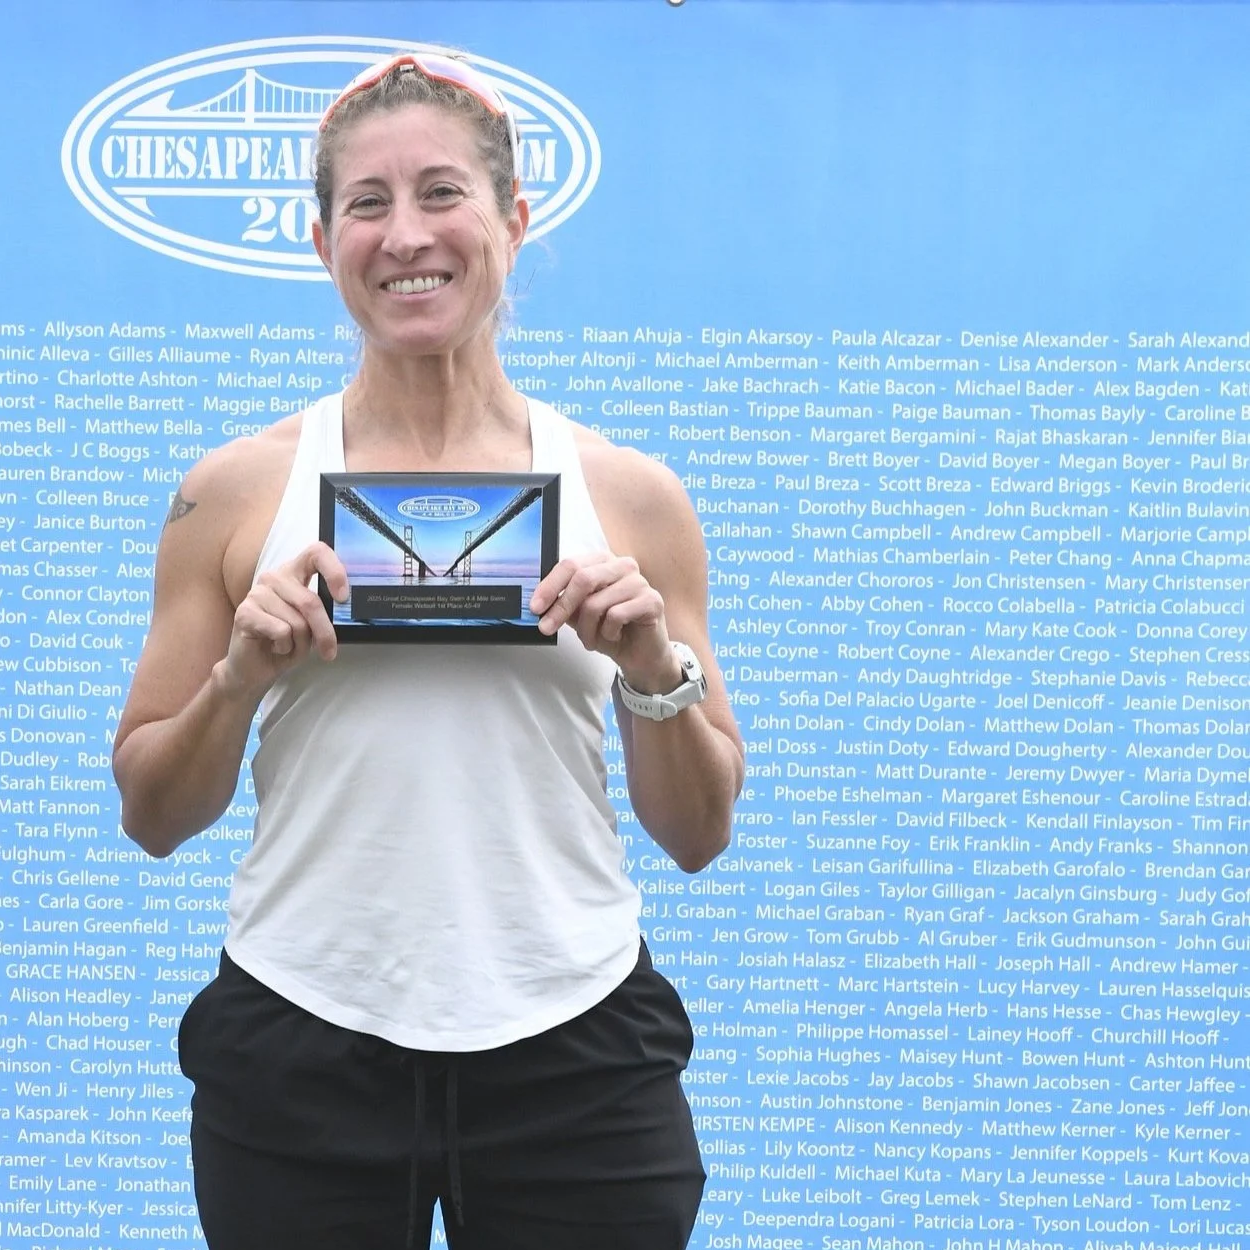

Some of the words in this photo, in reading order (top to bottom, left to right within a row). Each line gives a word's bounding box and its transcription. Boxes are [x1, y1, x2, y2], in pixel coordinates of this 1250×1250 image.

[101, 135, 316, 180] CHESAPEA
[241, 197, 320, 243] 20
[832, 329, 877, 347] Paula
[881, 329, 942, 347] Alcazar
[960, 330, 1019, 348] Denise
[1022, 331, 1109, 348] Alexander
[810, 426, 886, 447] Margaret
[890, 427, 976, 448] Bergamini
[995, 428, 1037, 448] Rajat
[1041, 428, 1128, 446] Bhaskaran
[33, 513, 85, 530] Janice
[89, 514, 146, 531] Burton
[943, 596, 994, 613] Rocco
[997, 596, 1075, 614] Colabella
[1095, 598, 1157, 615] Patricia
[1160, 598, 1245, 615] Colabucci
[14, 679, 74, 696] Nathan
[79, 681, 122, 697] Dean
[875, 763, 915, 779] Matt
[919, 763, 987, 780] Durante
[1005, 765, 1066, 785] Jeremy
[1070, 765, 1125, 786] Dwyer
[877, 882, 928, 902] Taylor
[931, 882, 995, 903] Gilligan
[1013, 884, 1075, 904] Jacalyn
[1079, 885, 1157, 906] Ginsburg
[884, 1000, 943, 1021] Angela
[947, 1001, 988, 1018] Herb
[1007, 1002, 1048, 1019] Hans
[1053, 1003, 1102, 1020] Hesse
[874, 1141, 926, 1162] Nancy
[930, 1143, 992, 1162] Kopans
[1010, 1144, 1077, 1161] Jennifer
[1081, 1146, 1149, 1165] Koppels
